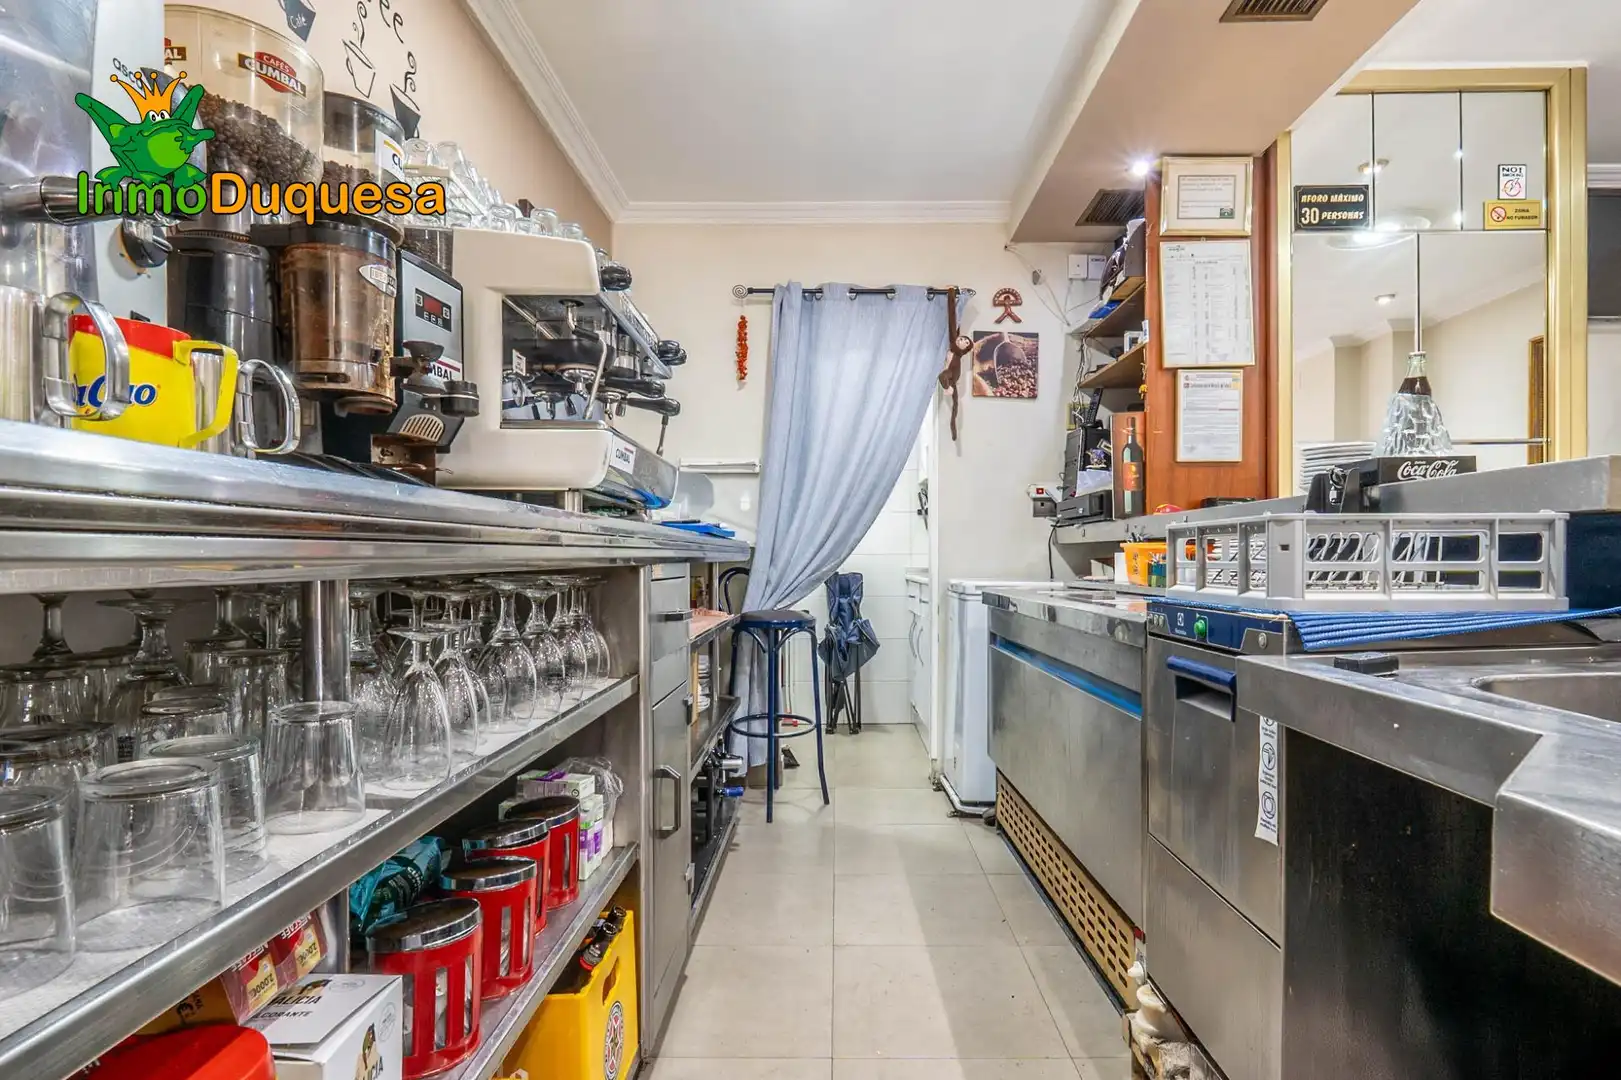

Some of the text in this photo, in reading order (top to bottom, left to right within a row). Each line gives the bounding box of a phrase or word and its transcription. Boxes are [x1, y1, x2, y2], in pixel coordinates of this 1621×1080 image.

[244, 58, 305, 94] CUMBAL
[1301, 193, 1365, 203] AFORO MÁXIMO
[1301, 207, 1365, 225] 30 PERSONAS
[1397, 460, 1459, 480] Coca-Cola
[269, 995, 322, 1006] ALICIA
